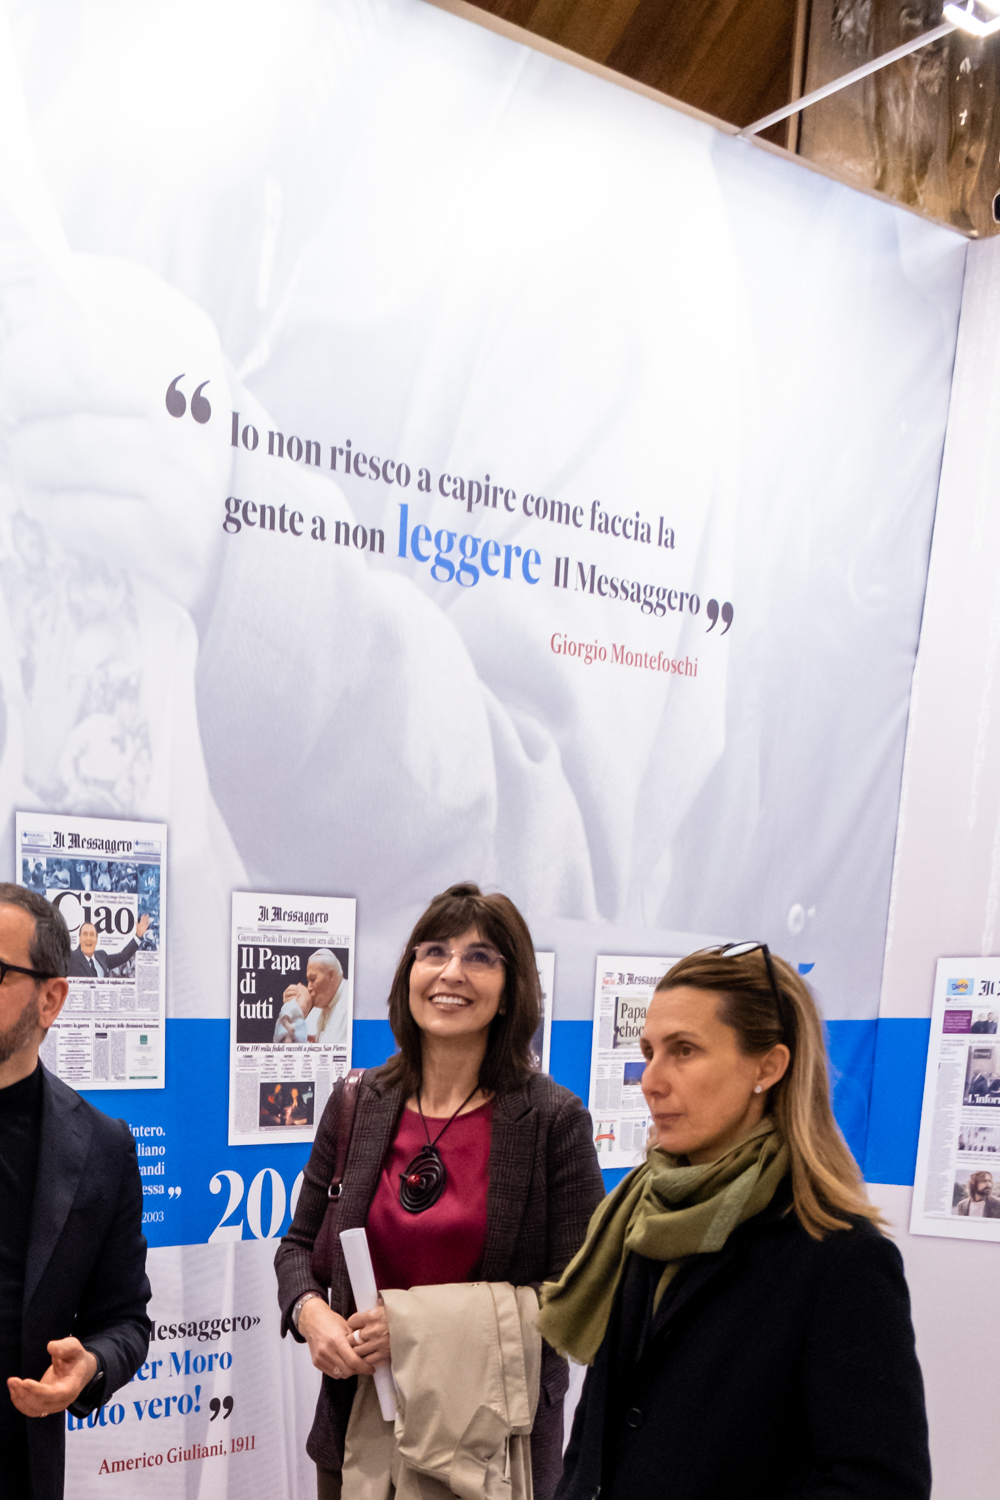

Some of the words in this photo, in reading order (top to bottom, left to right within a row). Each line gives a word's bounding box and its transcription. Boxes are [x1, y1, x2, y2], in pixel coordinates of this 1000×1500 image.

[230, 411, 259, 452] Io
[267, 428, 322, 468] non
[329, 439, 411, 488] riesco
[418, 468, 432, 494] a
[438, 471, 517, 513] capire
[522, 488, 584, 529] come
[589, 499, 652, 544] faccia
[657, 515, 676, 549] la
[223, 496, 304, 535] gente
[310, 513, 327, 542] a
[334, 519, 386, 554] non
[397, 503, 542, 587] leggere
[553, 556, 570, 590] Il
[550, 632, 607, 665] Giorgio
[610, 643, 698, 677] Montefoschi
[53, 831, 65, 848] Il
[68, 833, 132, 854] Messaggero
[52, 891, 135, 935] Ciao
[258, 905, 269, 922] Il
[271, 906, 329, 925] Messaggero
[241, 947, 254, 969] Il
[258, 947, 301, 975] Papa
[240, 972, 256, 994] di
[978, 980, 994, 996] Il
[239, 997, 273, 1019] tutti
[621, 1003, 647, 1023] Papa
[619, 1020, 645, 1038] choc
[142, 1210, 165, 1224] 2003
[129, 1359, 163, 1383] er
[168, 1350, 233, 1378] Moro
[132, 1384, 202, 1422] vero!
[98, 1452, 163, 1475] Americo
[167, 1439, 227, 1465] Giuliani,
[230, 1435, 256, 1454] 1911
